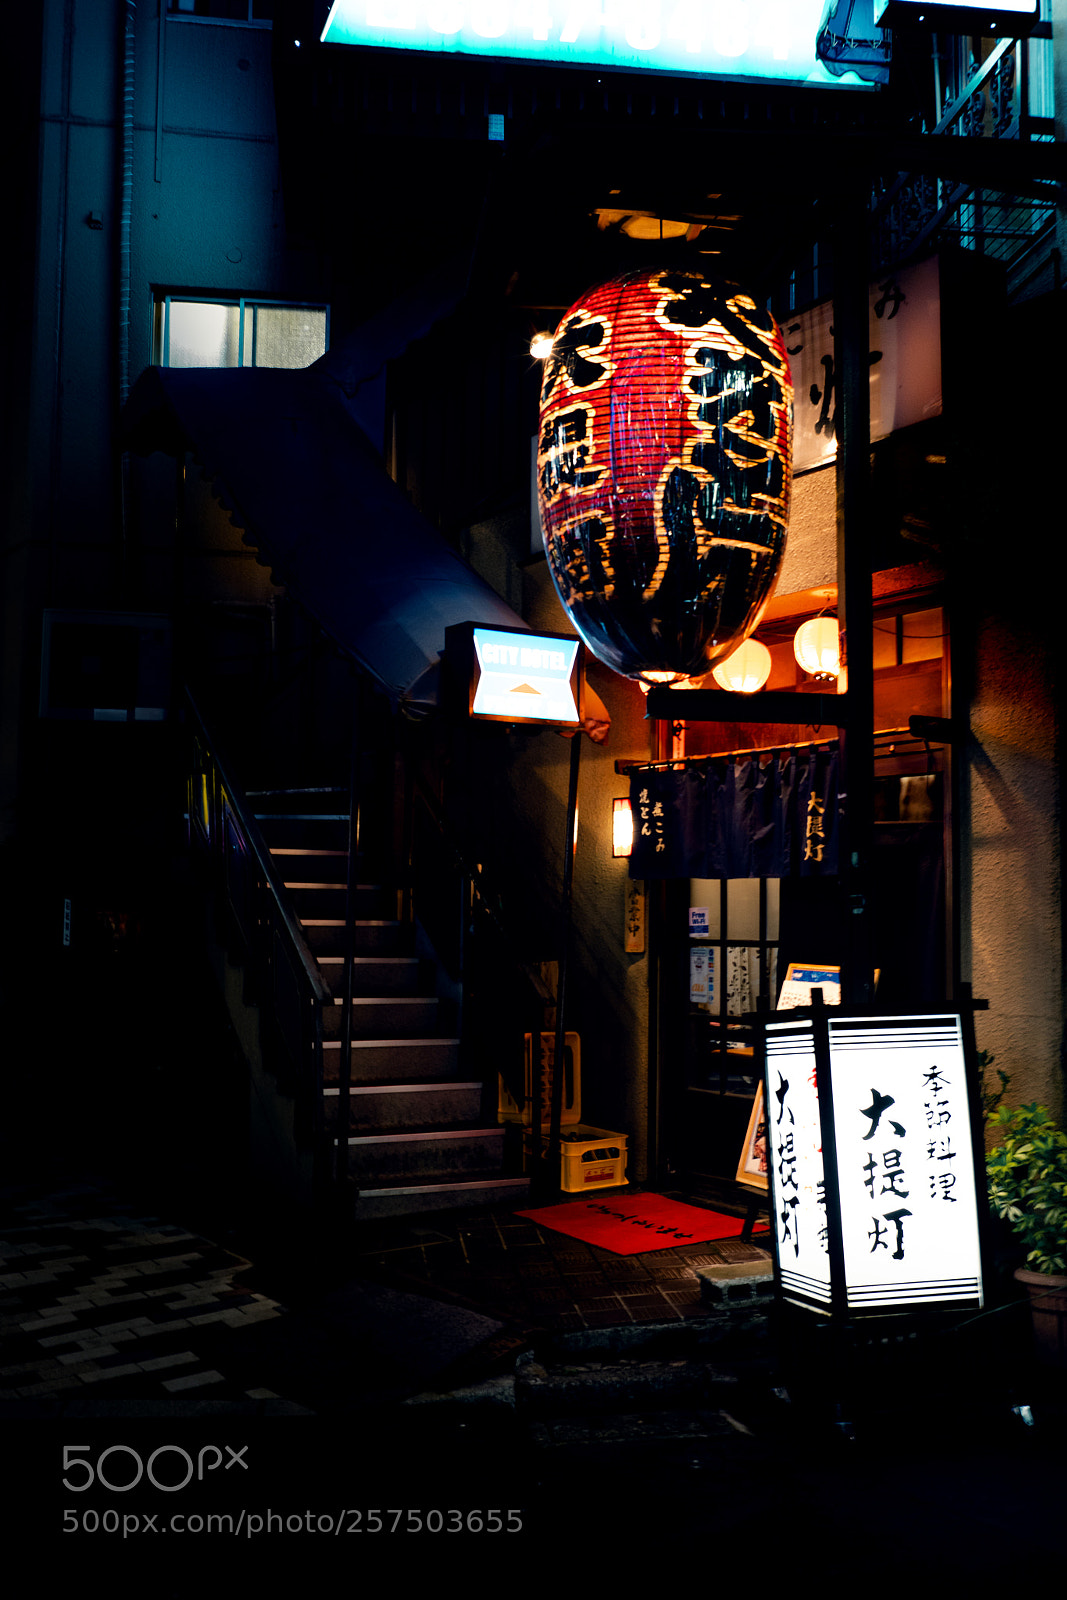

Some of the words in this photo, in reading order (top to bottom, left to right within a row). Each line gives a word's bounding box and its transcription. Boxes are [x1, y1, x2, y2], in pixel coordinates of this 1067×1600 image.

[481, 642, 520, 666] CITY
[520, 647, 568, 672] HOTEL
[775, 1069, 801, 1259] 大提灯
[859, 1087, 914, 1261] 大提灯
[921, 1065, 957, 1203] 季節料理
